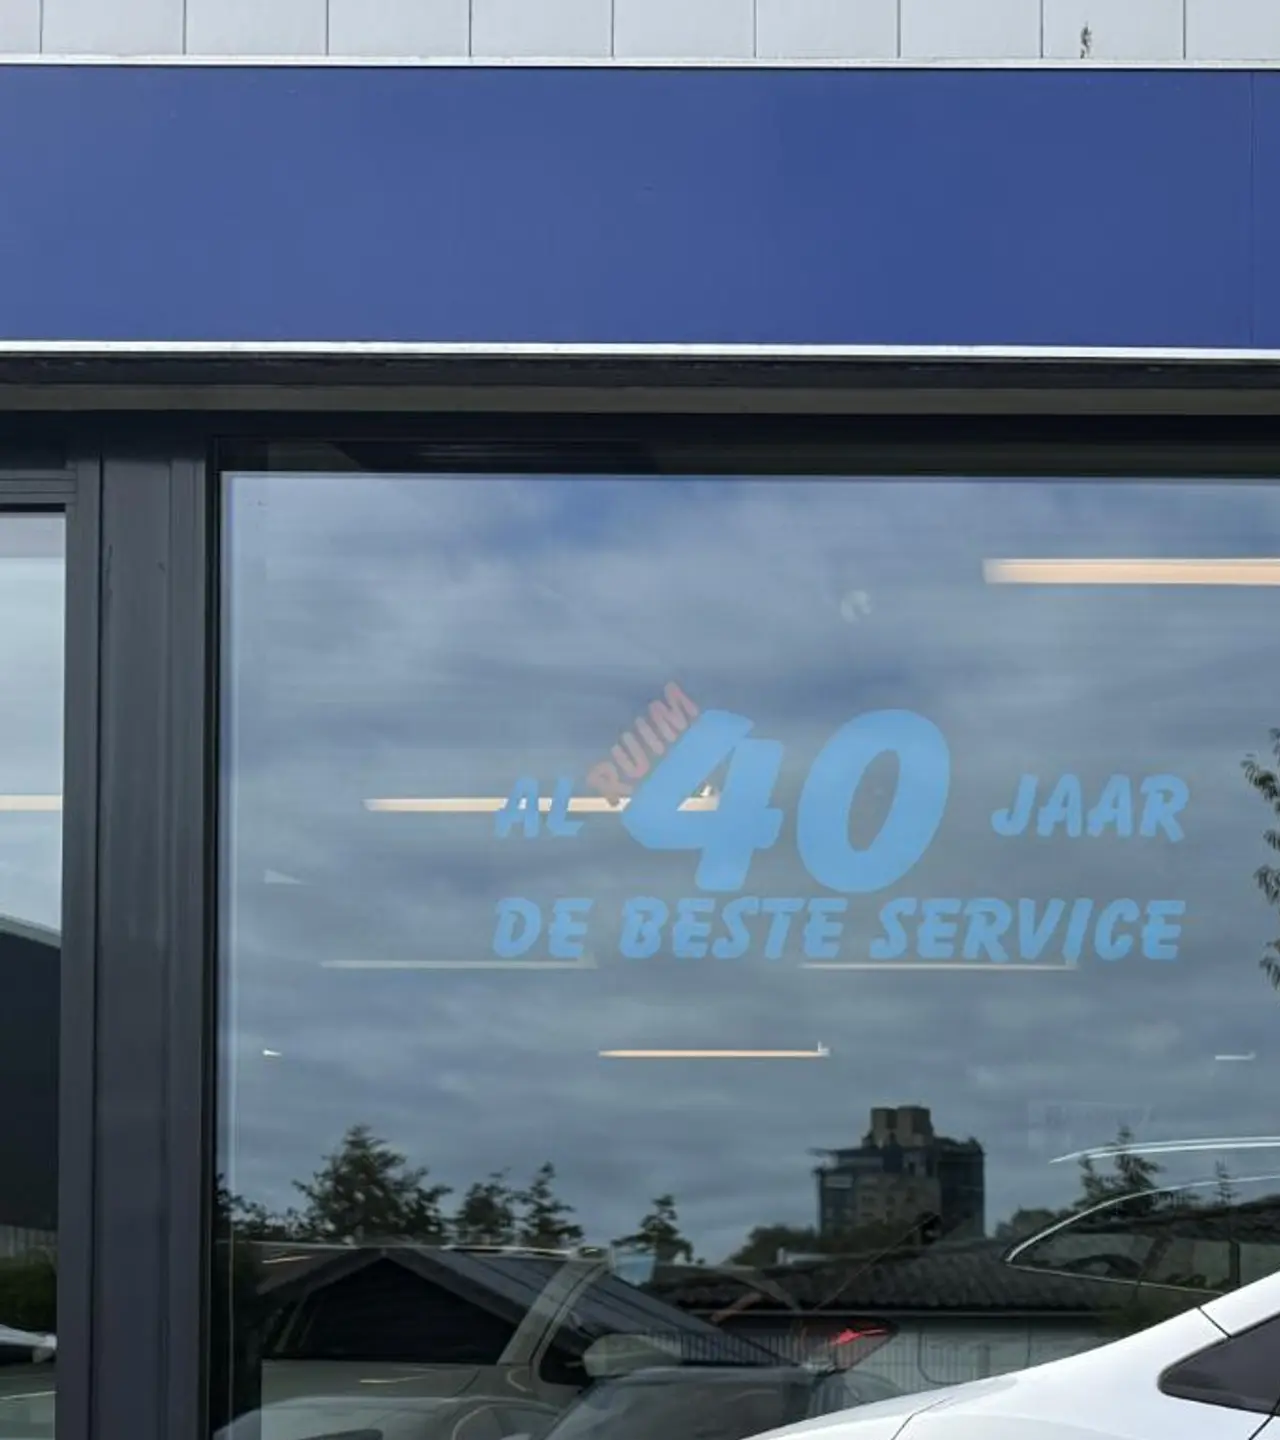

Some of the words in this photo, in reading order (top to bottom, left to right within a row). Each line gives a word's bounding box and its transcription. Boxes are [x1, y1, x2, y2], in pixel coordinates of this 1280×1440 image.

[495, 776, 584, 837] AL
[621, 709, 950, 892] 40
[991, 774, 1189, 841] JAAR
[587, 682, 699, 806] RUIM
[492, 896, 590, 959] DE
[618, 896, 848, 960] BESTE
[869, 897, 1185, 960] SERVICE
